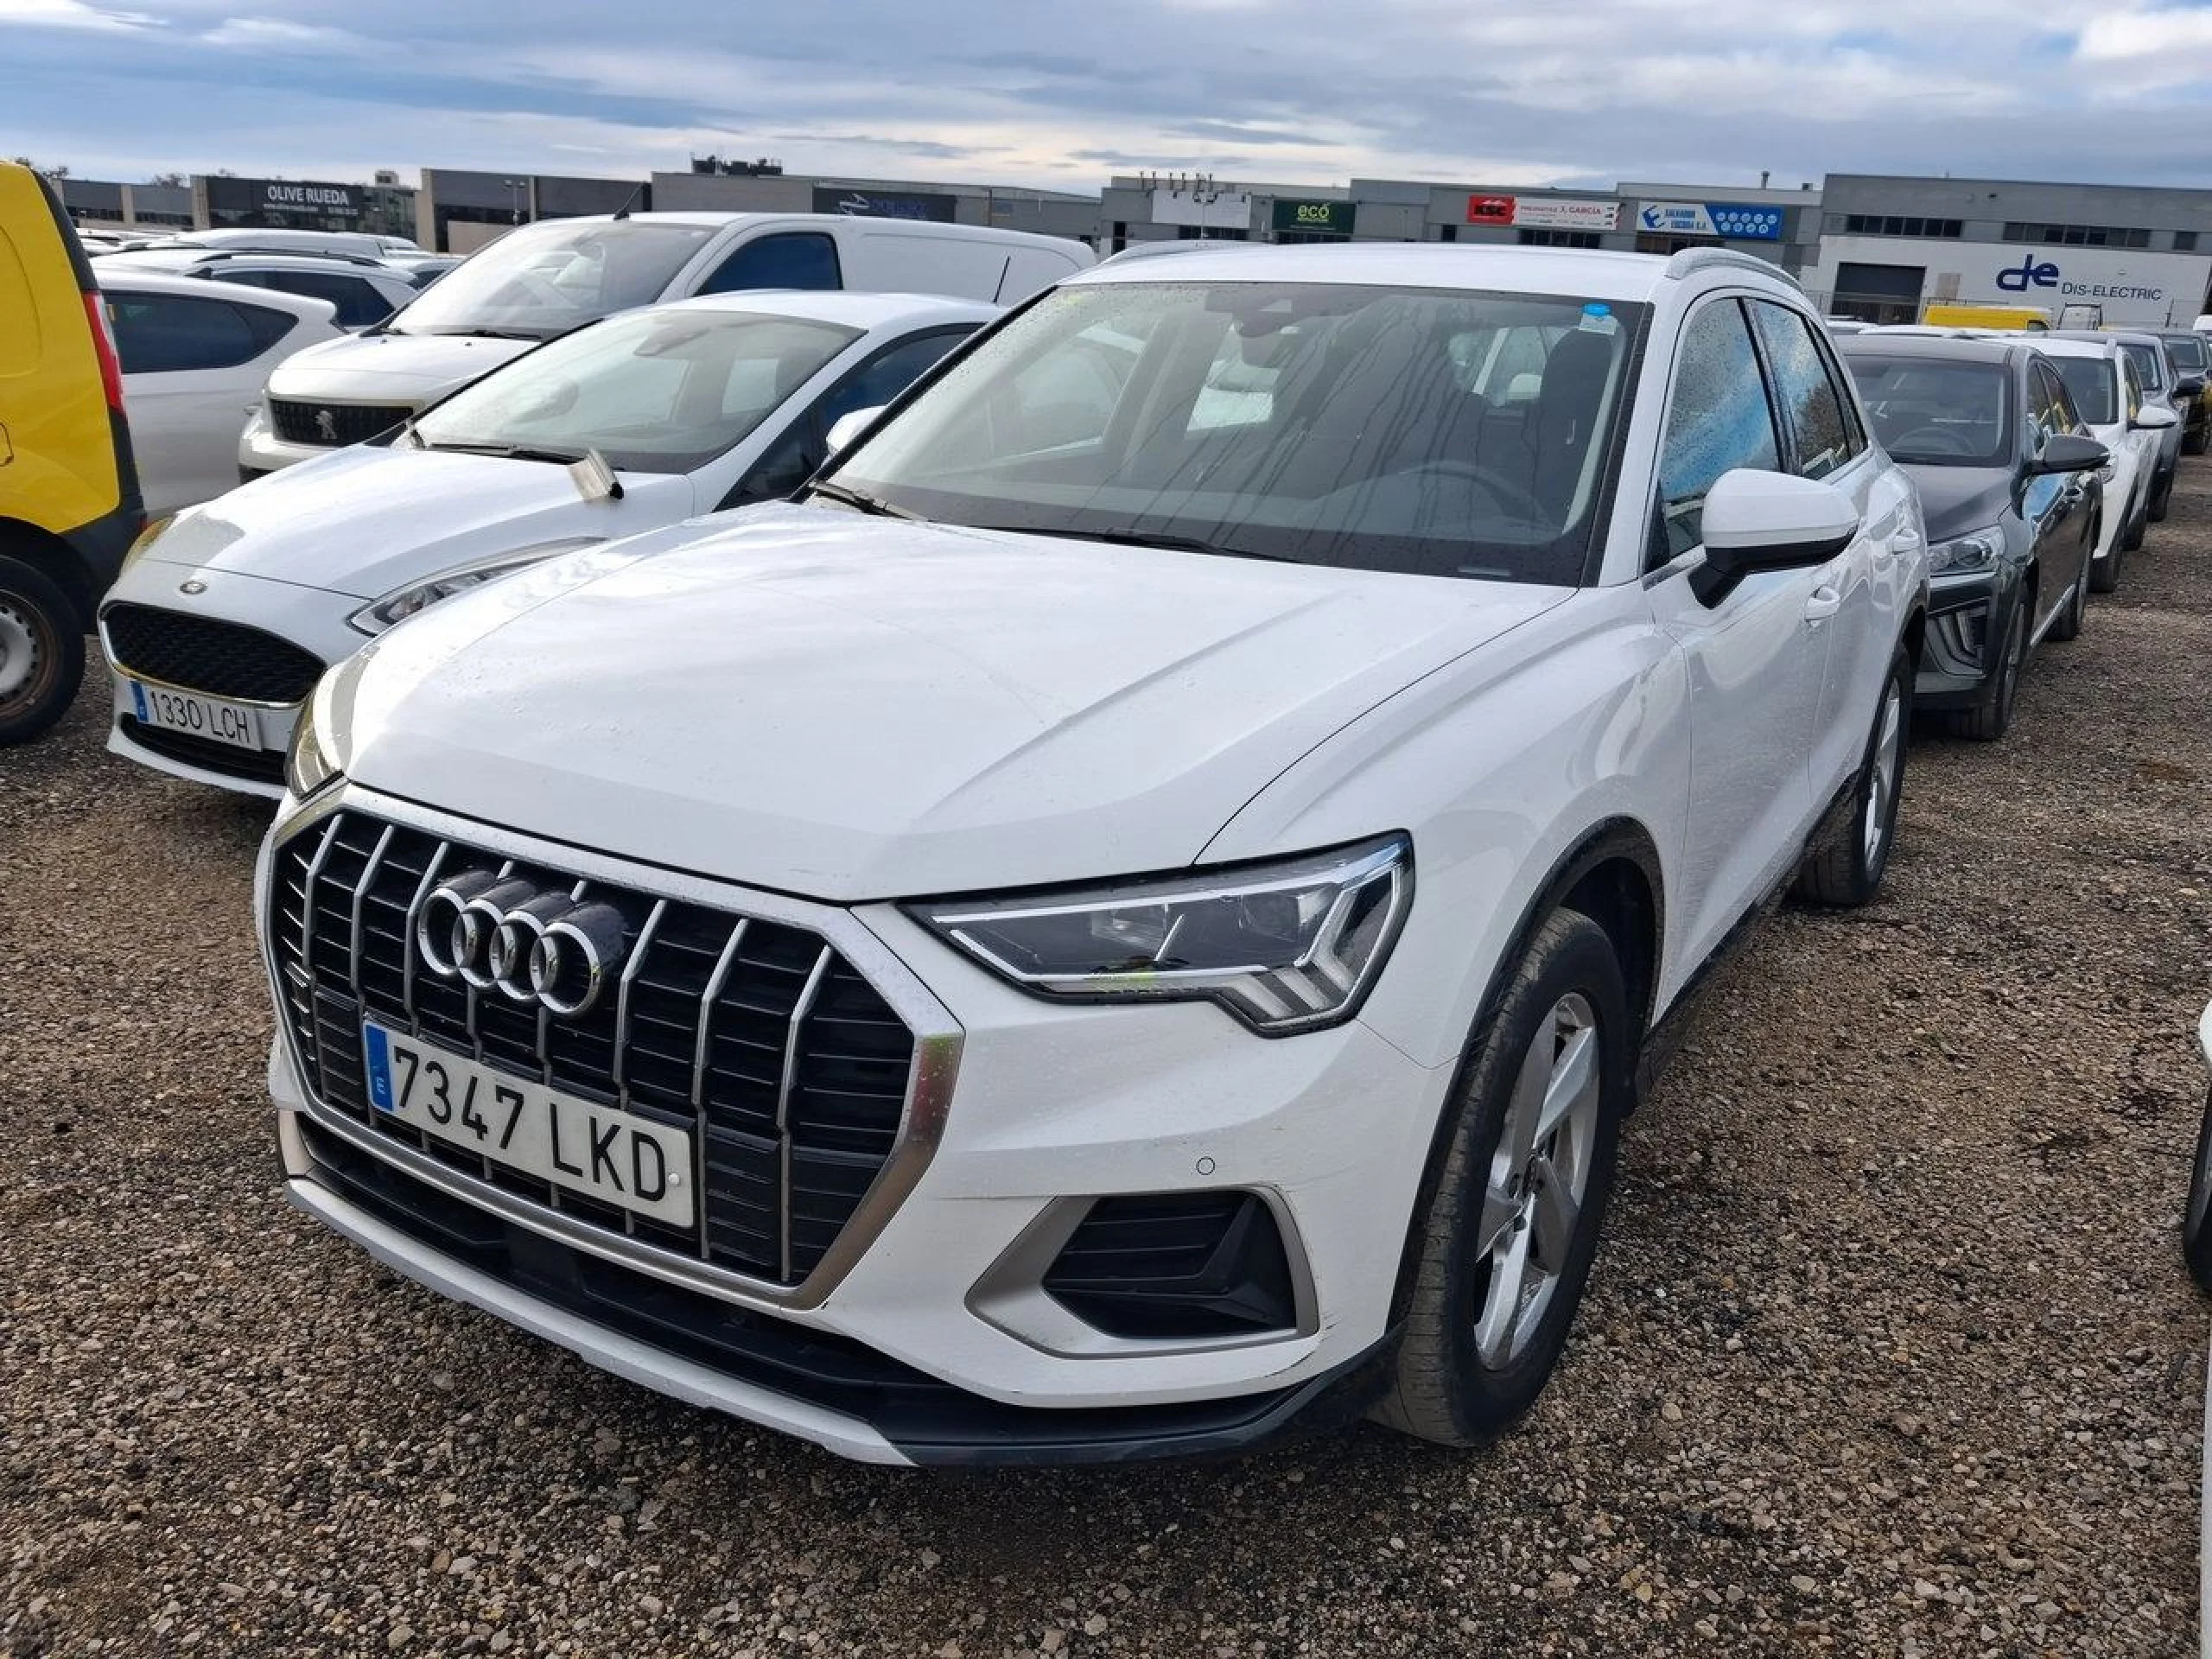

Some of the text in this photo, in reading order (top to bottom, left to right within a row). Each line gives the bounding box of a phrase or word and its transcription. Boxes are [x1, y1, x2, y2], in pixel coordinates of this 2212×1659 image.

[268, 186, 349, 205] OLIVE RUEDA
[2061, 282, 2162, 301] DIS-ELECTRIC
[150, 690, 250, 744] 1330 LCH
[393, 1046, 666, 1202] 7347 LKD
